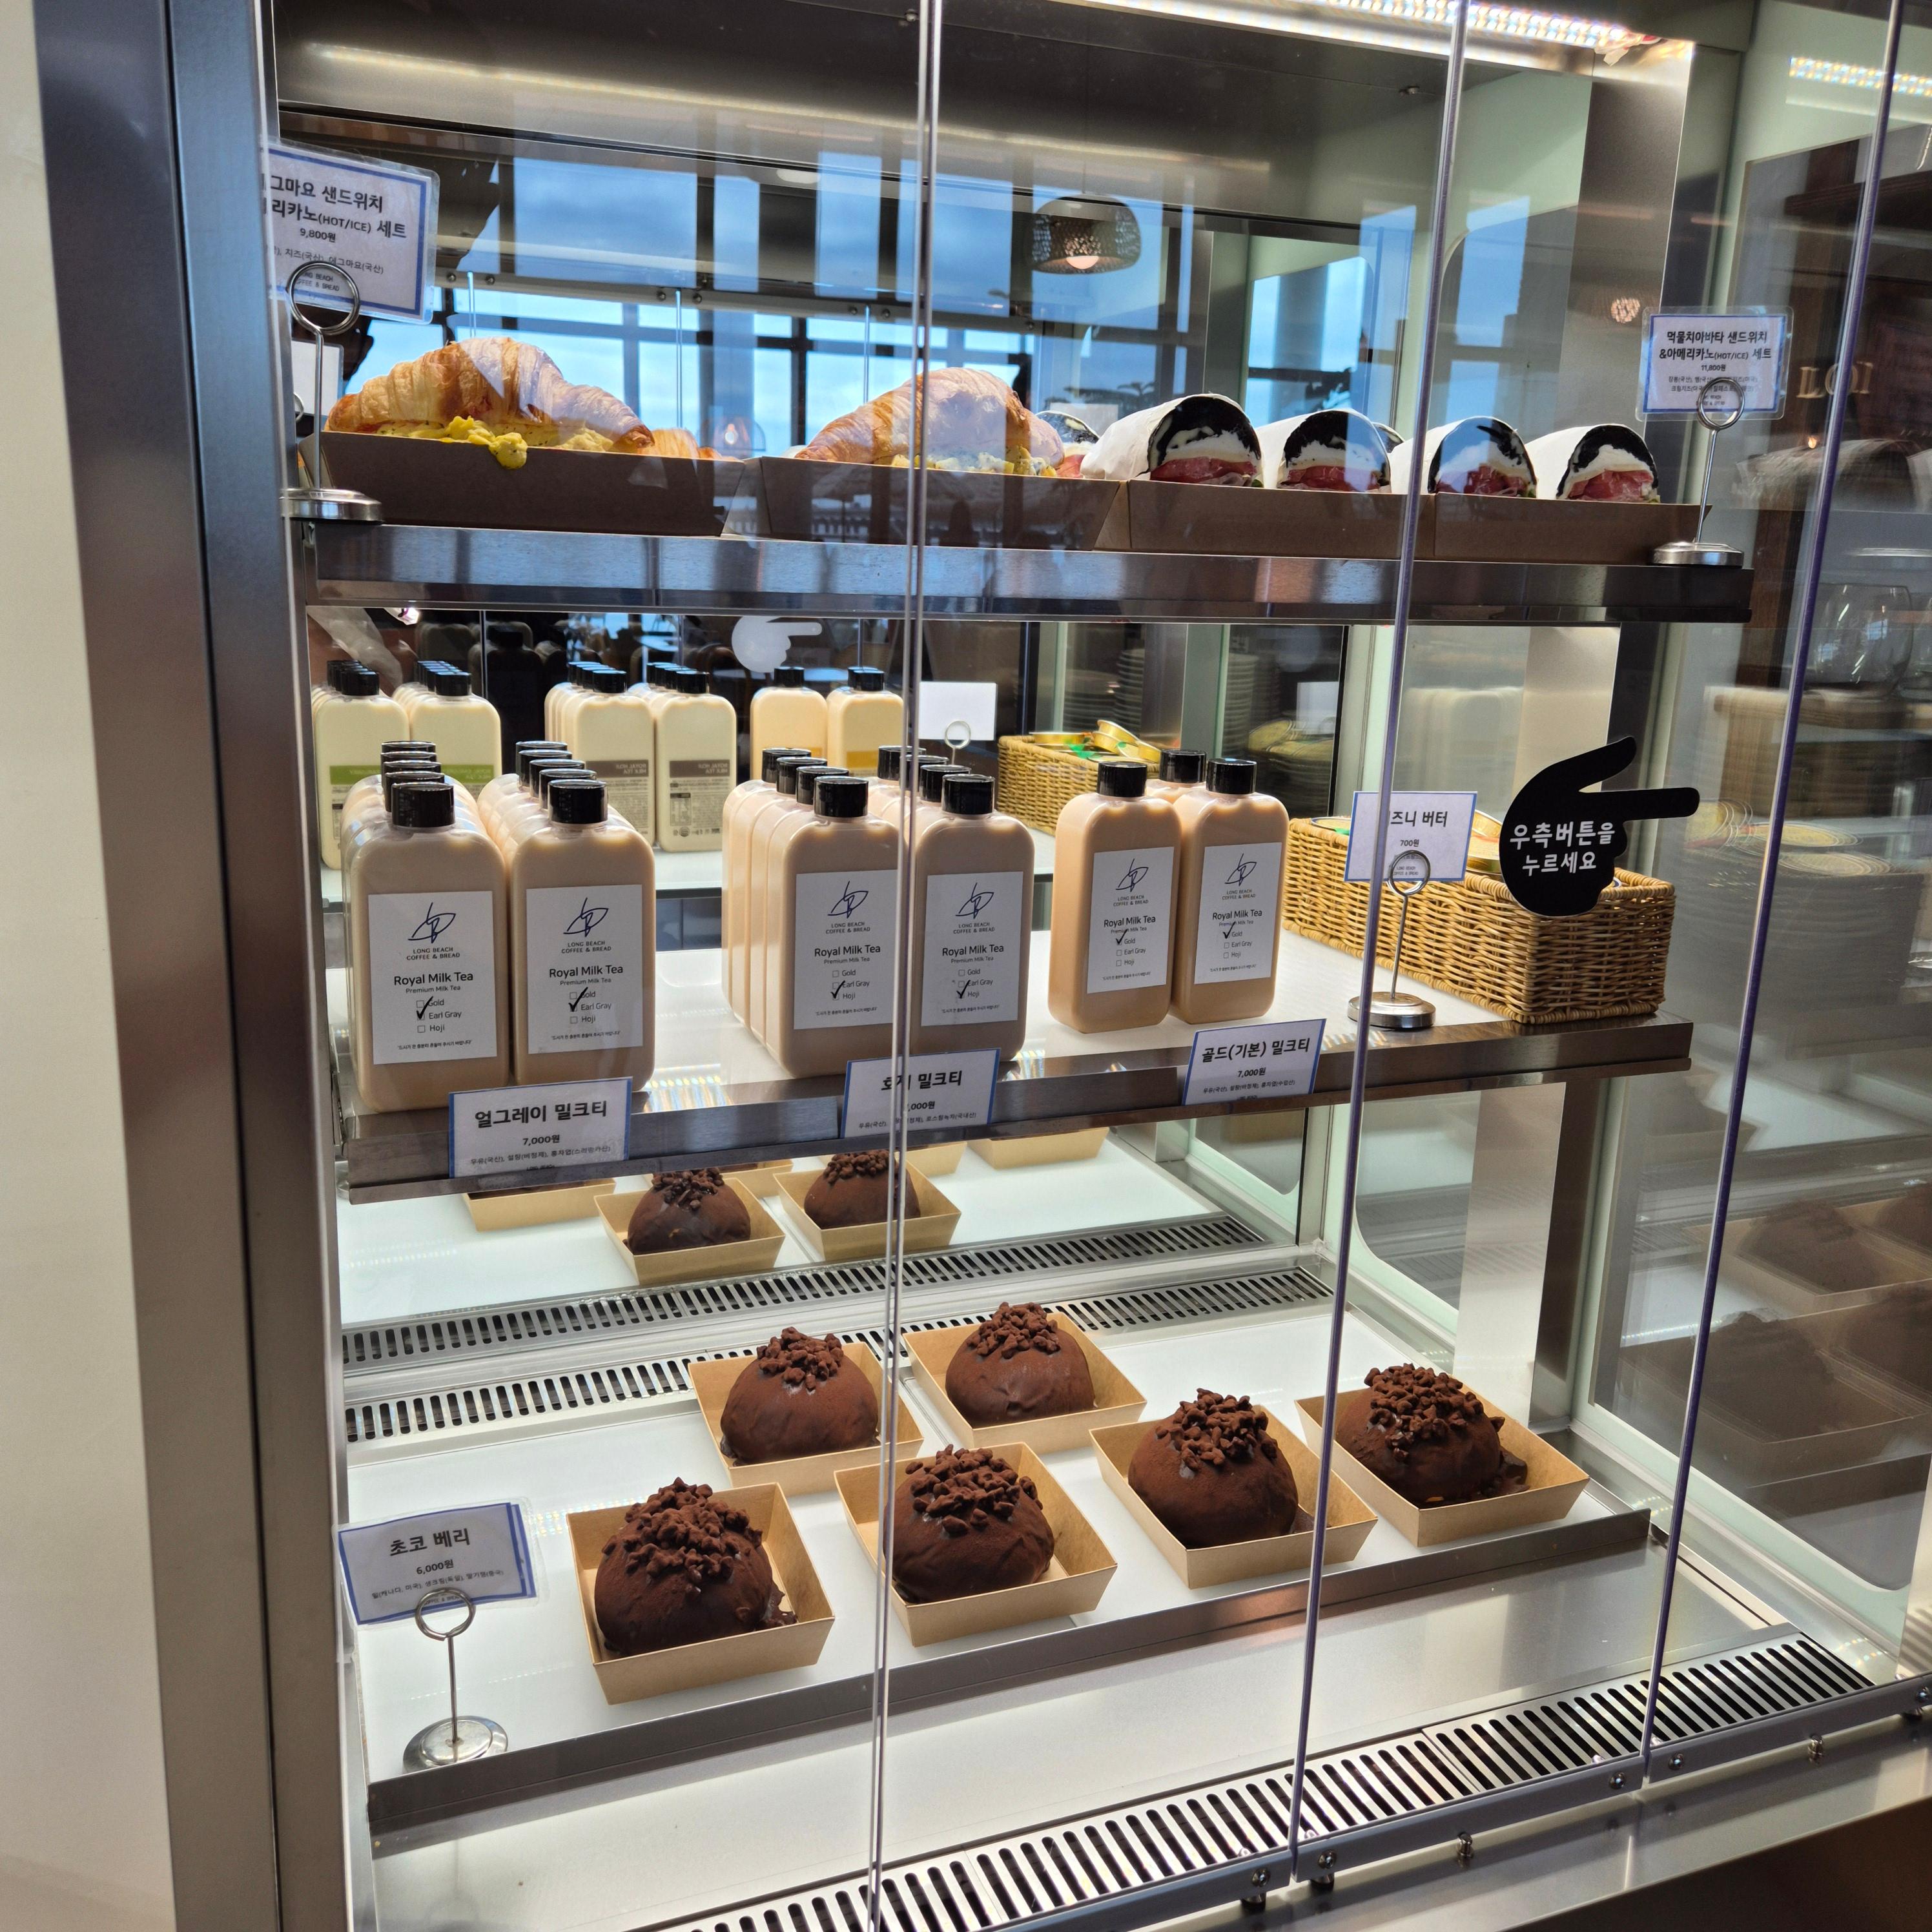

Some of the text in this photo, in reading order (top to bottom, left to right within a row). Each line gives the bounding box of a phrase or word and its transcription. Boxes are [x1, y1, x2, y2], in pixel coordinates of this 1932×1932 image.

[271, 175, 383, 212] 그마요 샌드위치
[272, 200, 406, 238] 리카노(HOT/ICE) 세트
[300, 228, 336, 243] 9,800원
[1667, 331, 1767, 344] 먹물치아바타 샌드위치
[1659, 348, 1771, 360] &아메리카노(HOT/ICE) 세트
[1388, 810, 1448, 827] 즈니 버터
[1522, 852, 1596, 876] 누르세요
[1104, 915, 1156, 929] Royal Milk Tea
[1213, 911, 1232, 921] Royal
[1251, 909, 1262, 917] Tea
[815, 945, 881, 958] Royal Milk Tea
[942, 944, 1004, 957] Royal Milk Tea
[550, 965, 623, 979] Royal Milk Tea
[394, 972, 473, 987] Royal Milk Tea
[445, 1011, 462, 1019] Gray
[430, 1024, 445, 1033] Hoji
[1202, 1038, 1310, 1063] 골드(기본) 밀크티
[1238, 1067, 1266, 1078] 7,000원
[918, 1071, 962, 1089] 밀크티
[907, 1101, 935, 1112] ,000원
[475, 1101, 607, 1128] 얼그레이 밀크티
[522, 1135, 560, 1146] 7,000원
[390, 1528, 470, 1556] 초코 베리
[416, 1559, 453, 1575] 6,000원
